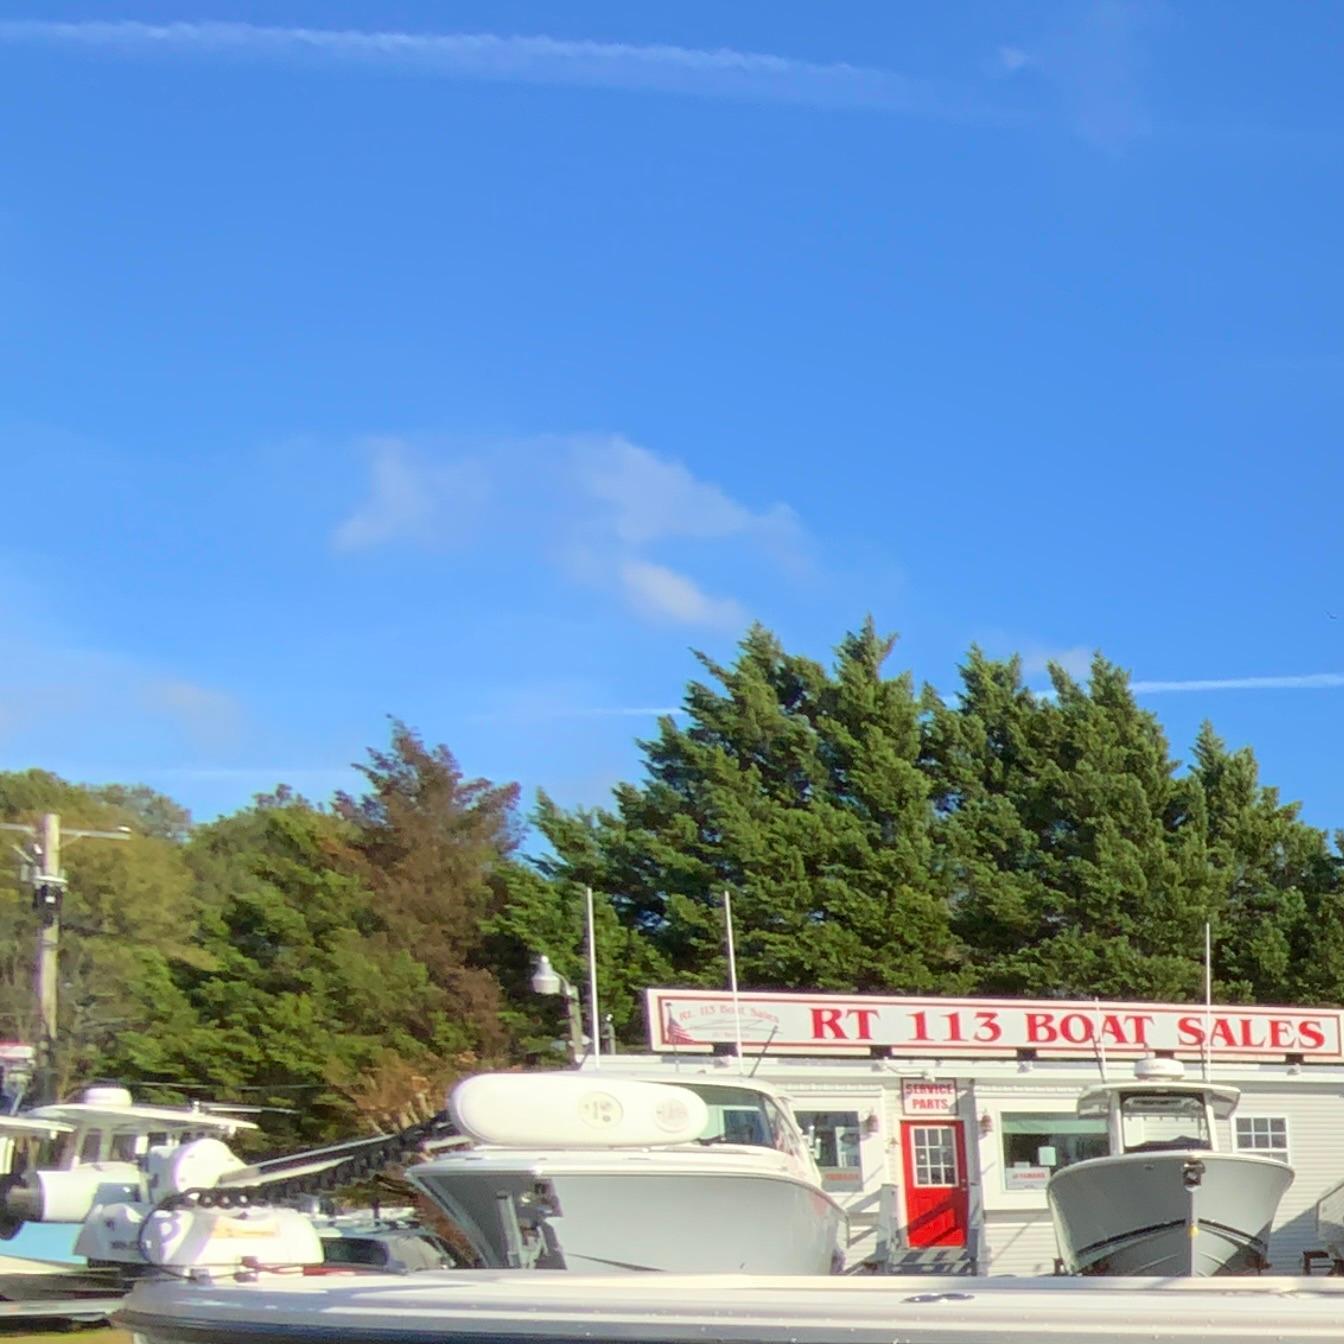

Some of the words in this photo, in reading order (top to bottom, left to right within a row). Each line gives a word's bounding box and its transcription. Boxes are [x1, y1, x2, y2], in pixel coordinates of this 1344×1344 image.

[810, 1007, 880, 1040] RT
[908, 1010, 1002, 1042] 113
[1025, 1012, 1155, 1044] BOAT
[1176, 1016, 1326, 1049] SALES
[905, 1083, 953, 1095] SERVICE
[912, 1098, 949, 1110] PARTS
